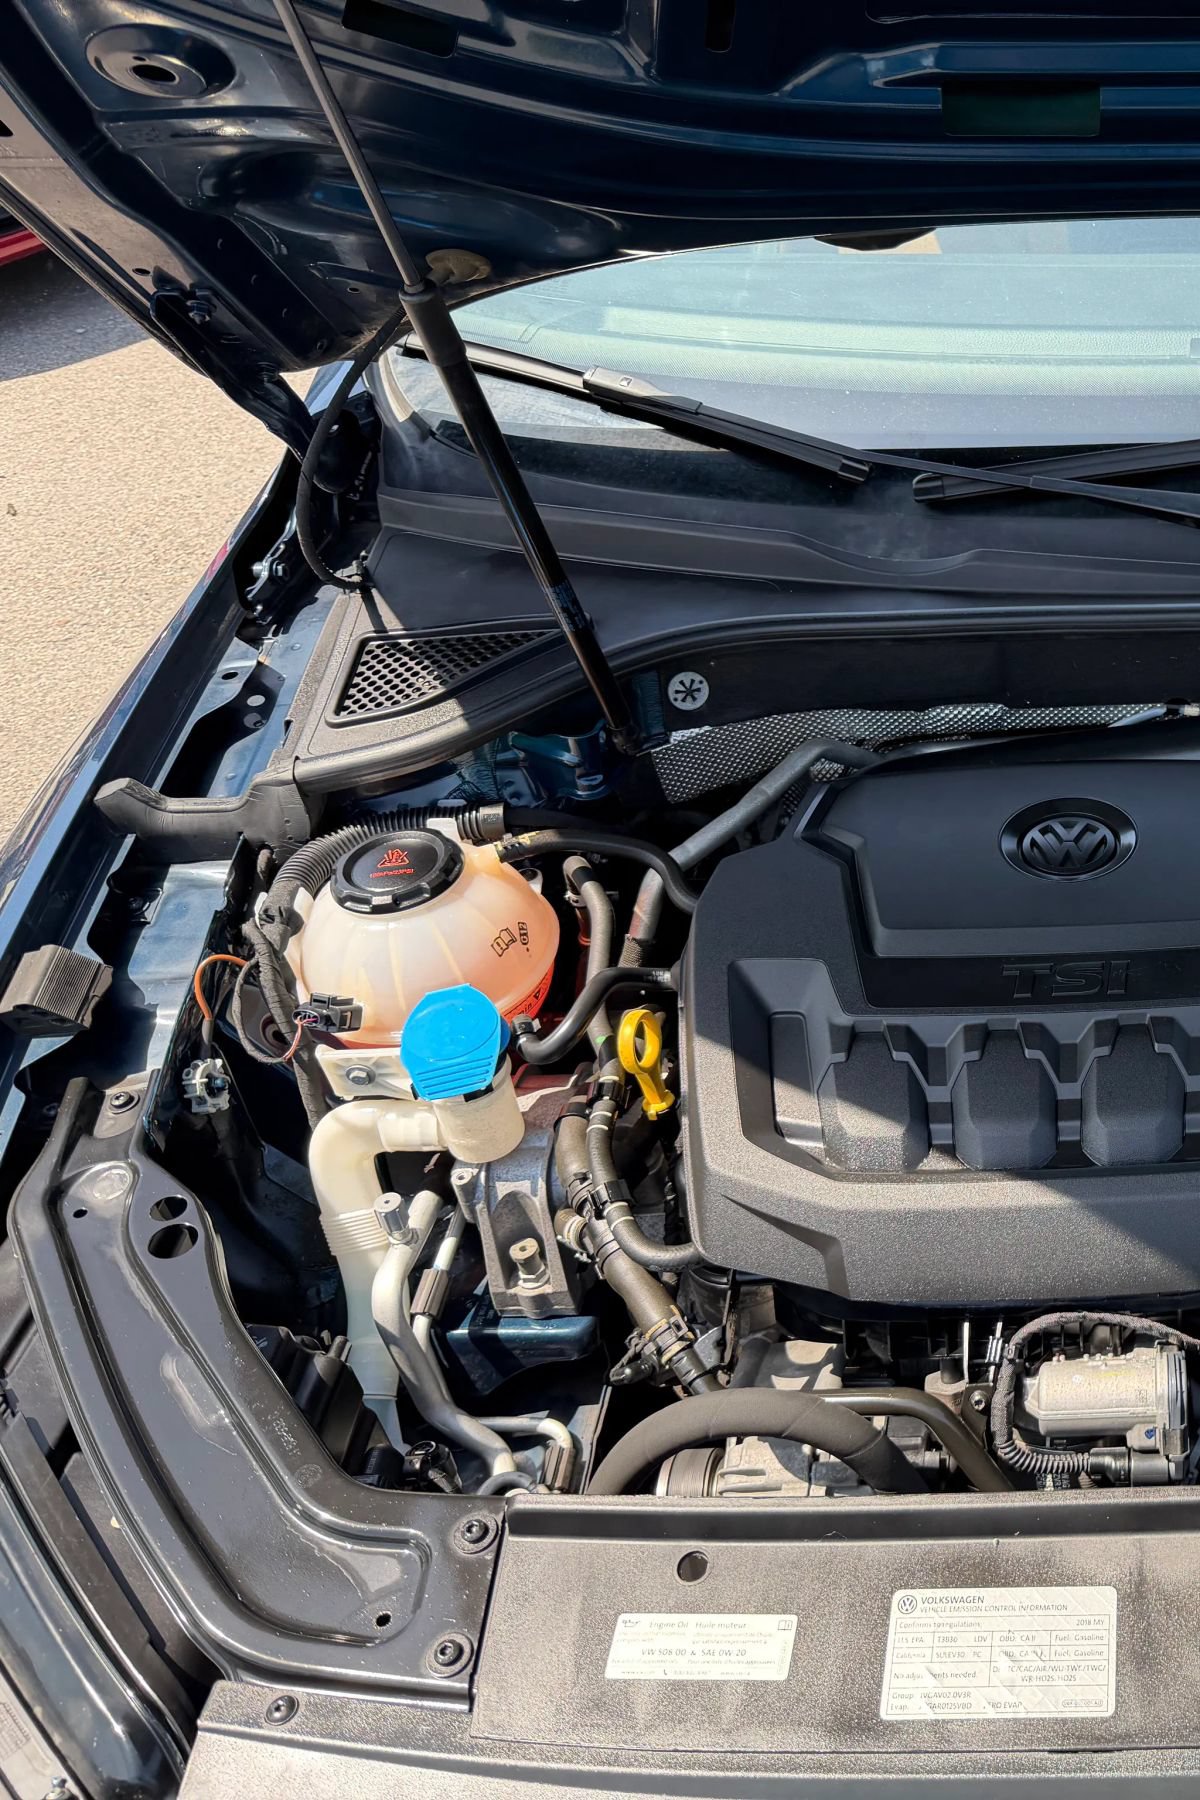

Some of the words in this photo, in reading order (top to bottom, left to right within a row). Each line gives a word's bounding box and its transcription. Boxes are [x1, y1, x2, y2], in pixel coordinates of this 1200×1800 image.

[1002, 960, 1131, 999] TSI
[921, 1595, 985, 1605] VOLKSWAGEN
[920, 1605, 947, 1613] VEHICLE
[949, 1605, 983, 1613] EMISSION
[984, 1604, 1016, 1612] CONTROL
[1018, 1603, 1068, 1612] INFORMATION
[649, 1620, 676, 1630] Engine
[677, 1619, 689, 1629] Oil
[695, 1620, 716, 1630] Huile
[717, 1620, 747, 1630] moteur
[899, 1621, 932, 1629] Conforms
[1092, 1618, 1105, 1626] MY
[937, 1635, 958, 1643] T3B30
[1020, 1634, 1030, 1642] CA
[1055, 1634, 1070, 1642] Fuel:
[1074, 1633, 1105, 1641] Gasoline
[641, 1648, 656, 1657] VW
[701, 1648, 716, 1657] SAE
[896, 1651, 926, 1659] California
[1019, 1649, 1029, 1657] CA
[1054, 1649, 1070, 1657] Fuel:
[1074, 1649, 1105, 1657] Gasoline
[893, 1672, 904, 1680] No
[1003, 1700, 1023, 1709] EVAP
